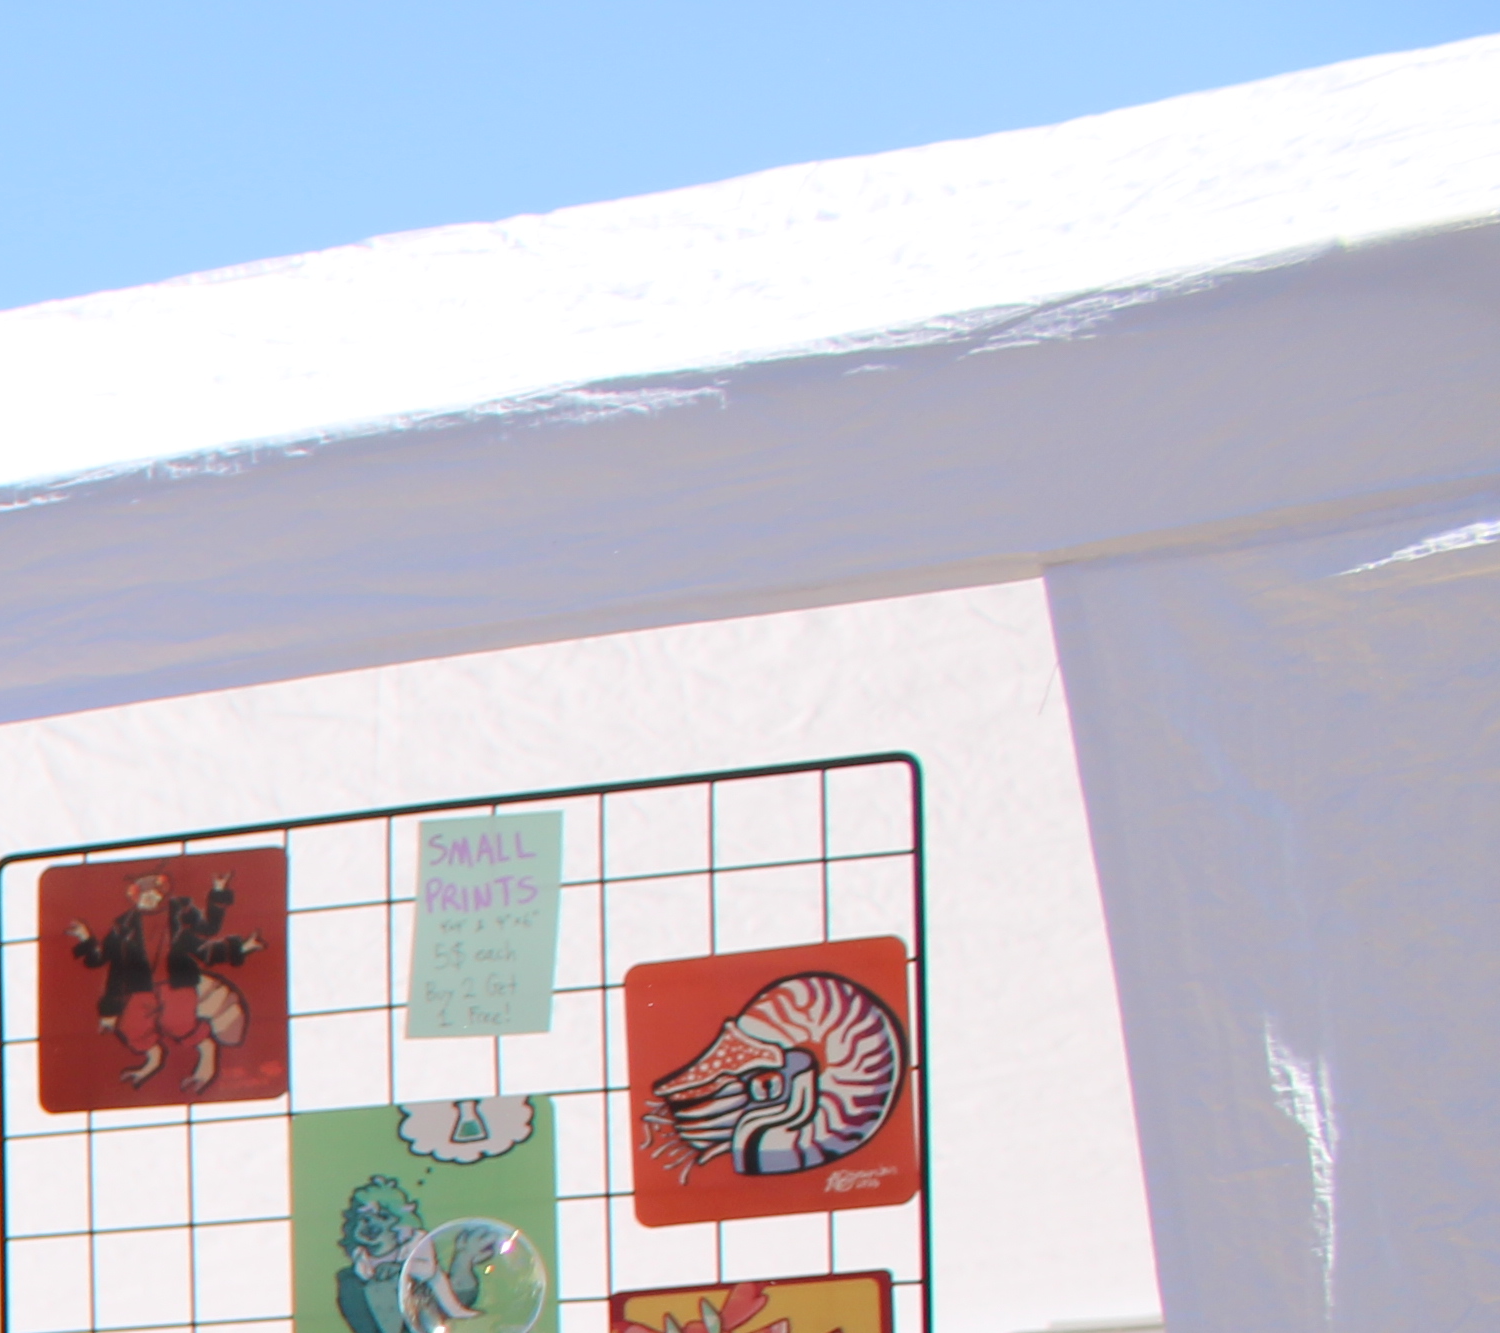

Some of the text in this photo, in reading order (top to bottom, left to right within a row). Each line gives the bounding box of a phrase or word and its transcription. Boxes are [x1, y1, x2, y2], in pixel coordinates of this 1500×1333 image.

[427, 831, 538, 868] SMALL
[424, 875, 540, 914] PRINTS
[474, 941, 516, 961] each
[462, 977, 477, 998] 2
[486, 973, 518, 997] Get
